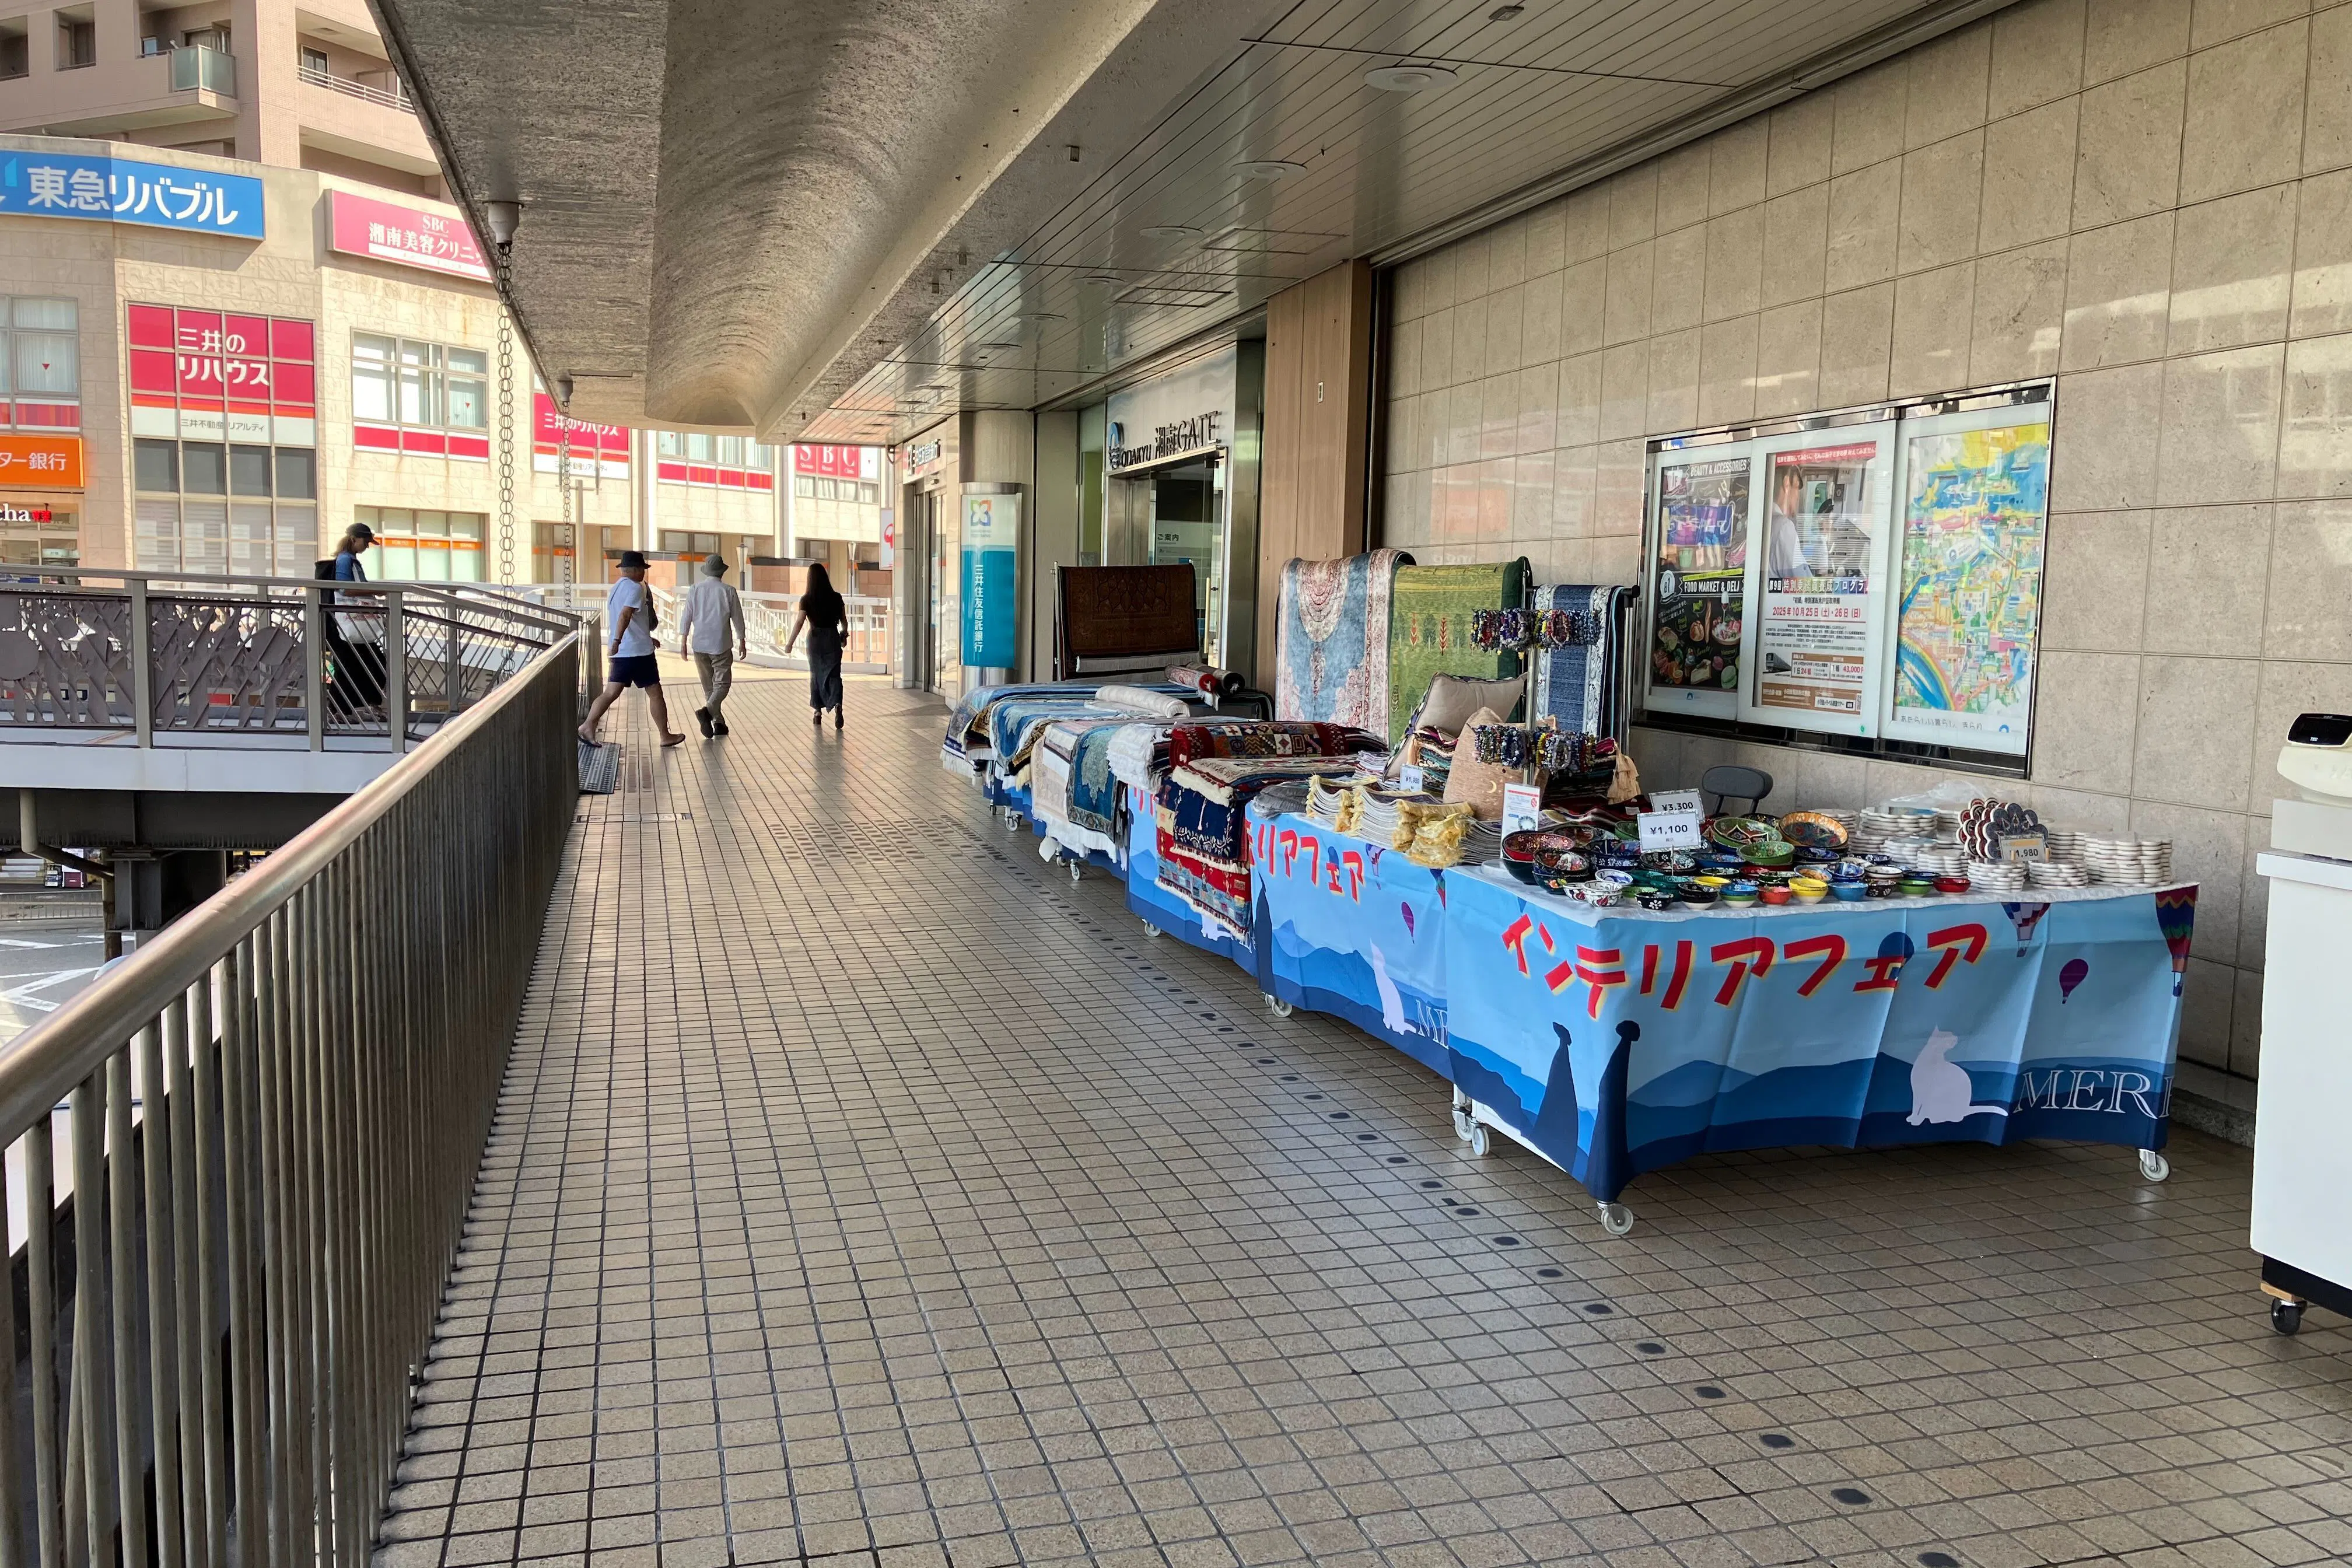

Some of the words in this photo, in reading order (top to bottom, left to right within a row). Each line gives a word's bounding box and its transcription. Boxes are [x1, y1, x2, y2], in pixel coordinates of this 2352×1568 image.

[27, 166, 239, 225] 東急リバブル
[422, 215, 449, 233] SBC
[178, 327, 246, 354] 三井の
[178, 356, 270, 386] リハウス
[180, 418, 265, 432] 三井不動産リアルティ
[1121, 443, 1152, 467] ODAKYU
[1690, 464, 1709, 477] BEAUTY
[1714, 459, 1747, 474] ACCESSORIES
[1157, 533, 1179, 541] ご案内
[1684, 581, 1698, 593] FOOD
[1698, 580, 1720, 593] MARKET
[1721, 582, 1725, 592] &
[1726, 580, 1740, 592] DELI
[974, 564, 984, 653] 三井住友信託銀行
[1650, 824, 1688, 835] ¥1,100
[2010, 848, 2039, 858] 1,980
[1502, 912, 1988, 1019] インテリアフェア
